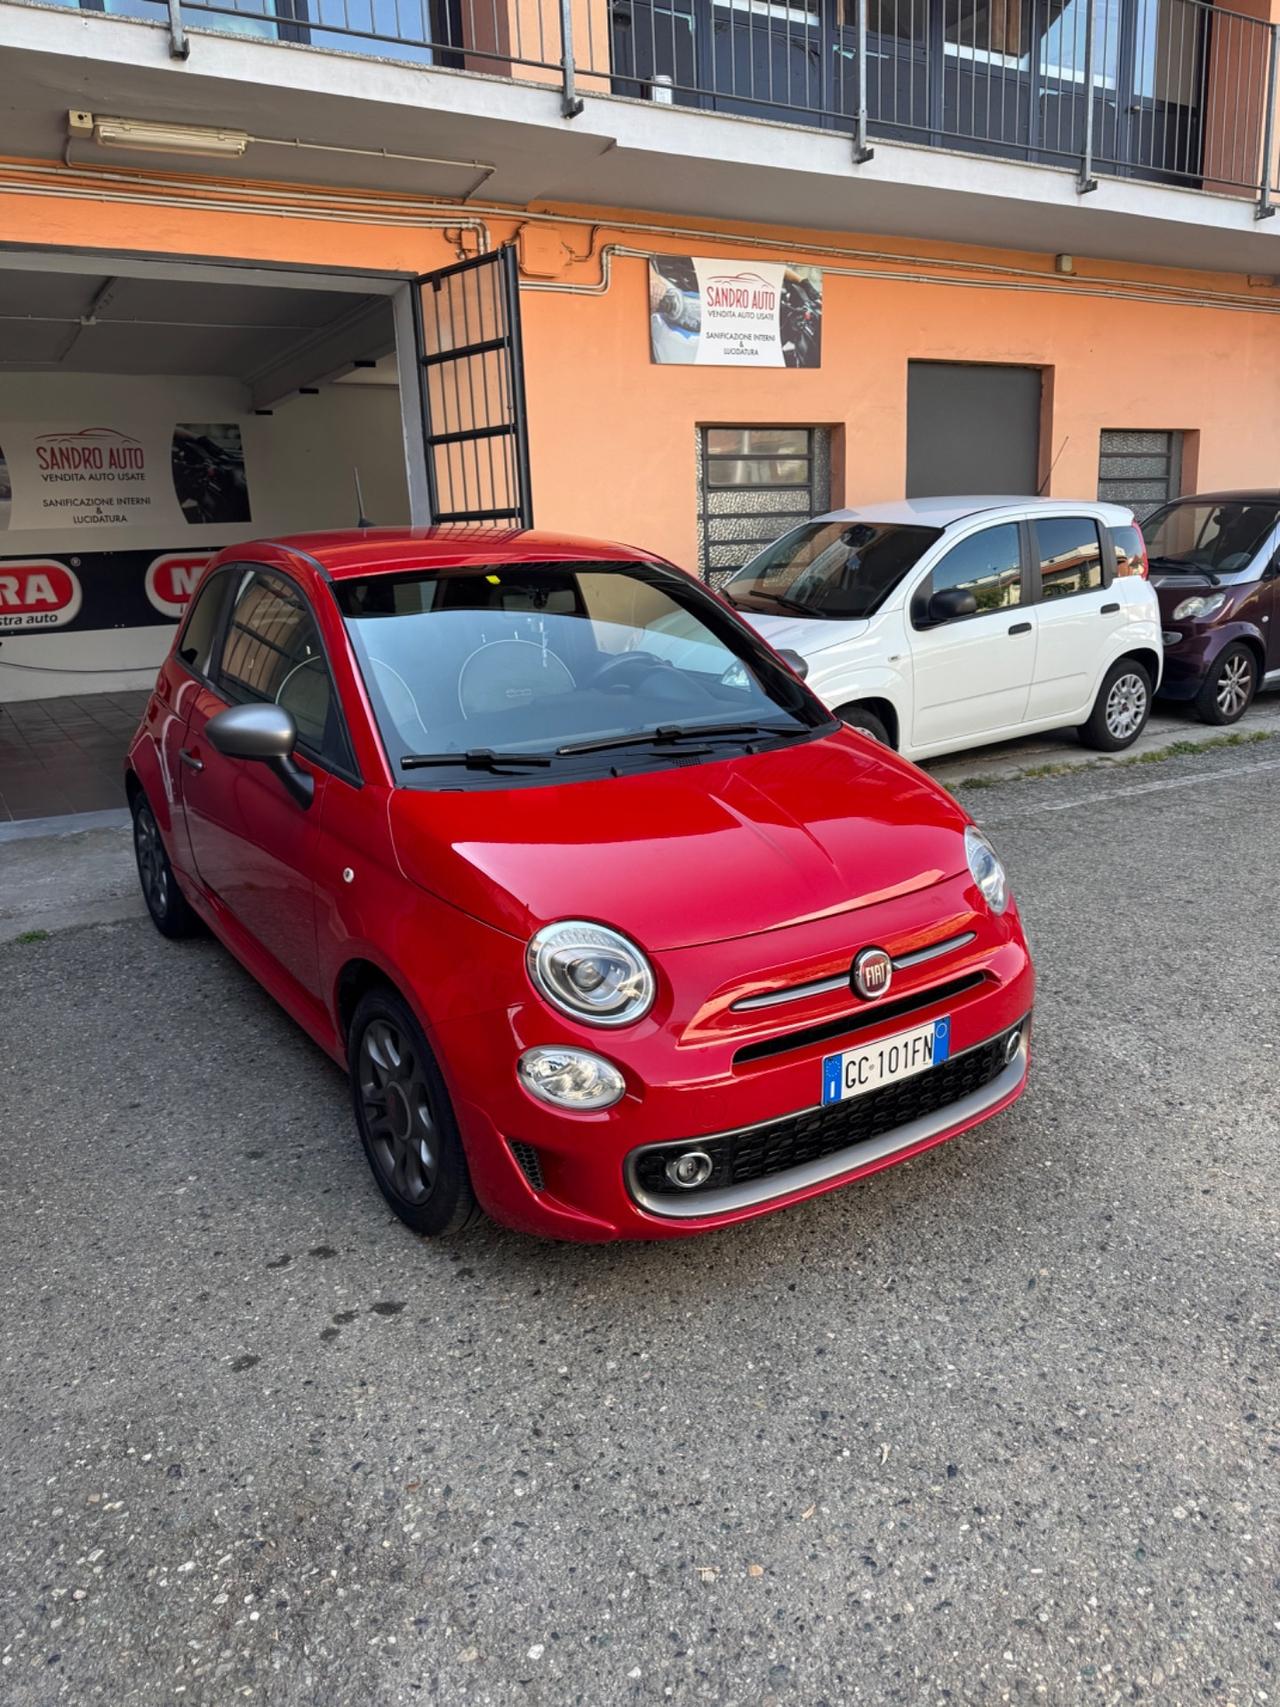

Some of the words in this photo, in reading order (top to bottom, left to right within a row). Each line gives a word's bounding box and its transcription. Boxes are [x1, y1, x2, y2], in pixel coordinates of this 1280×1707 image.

[706, 286, 749, 308] SANDRO
[752, 291, 776, 311] AUTO
[708, 310, 737, 318] VENDITA
[737, 311, 756, 319] AUTO
[756, 312, 775, 320] USATE
[706, 332, 752, 341] SANIFICAZIONE
[36, 446, 103, 471] SANDRO
[109, 447, 145, 470] AUTO
[42, 473, 86, 482] VENDITA
[88, 473, 115, 482] AUTO
[117, 472, 146, 481] USATE
[43, 498, 115, 508] SANIFICAZIONE
[116, 497, 151, 506] INTERNI
[73, 515, 128, 525] LUCIDATURA
[26, 614, 58, 624] auto
[864, 962, 886, 987] FIAT
